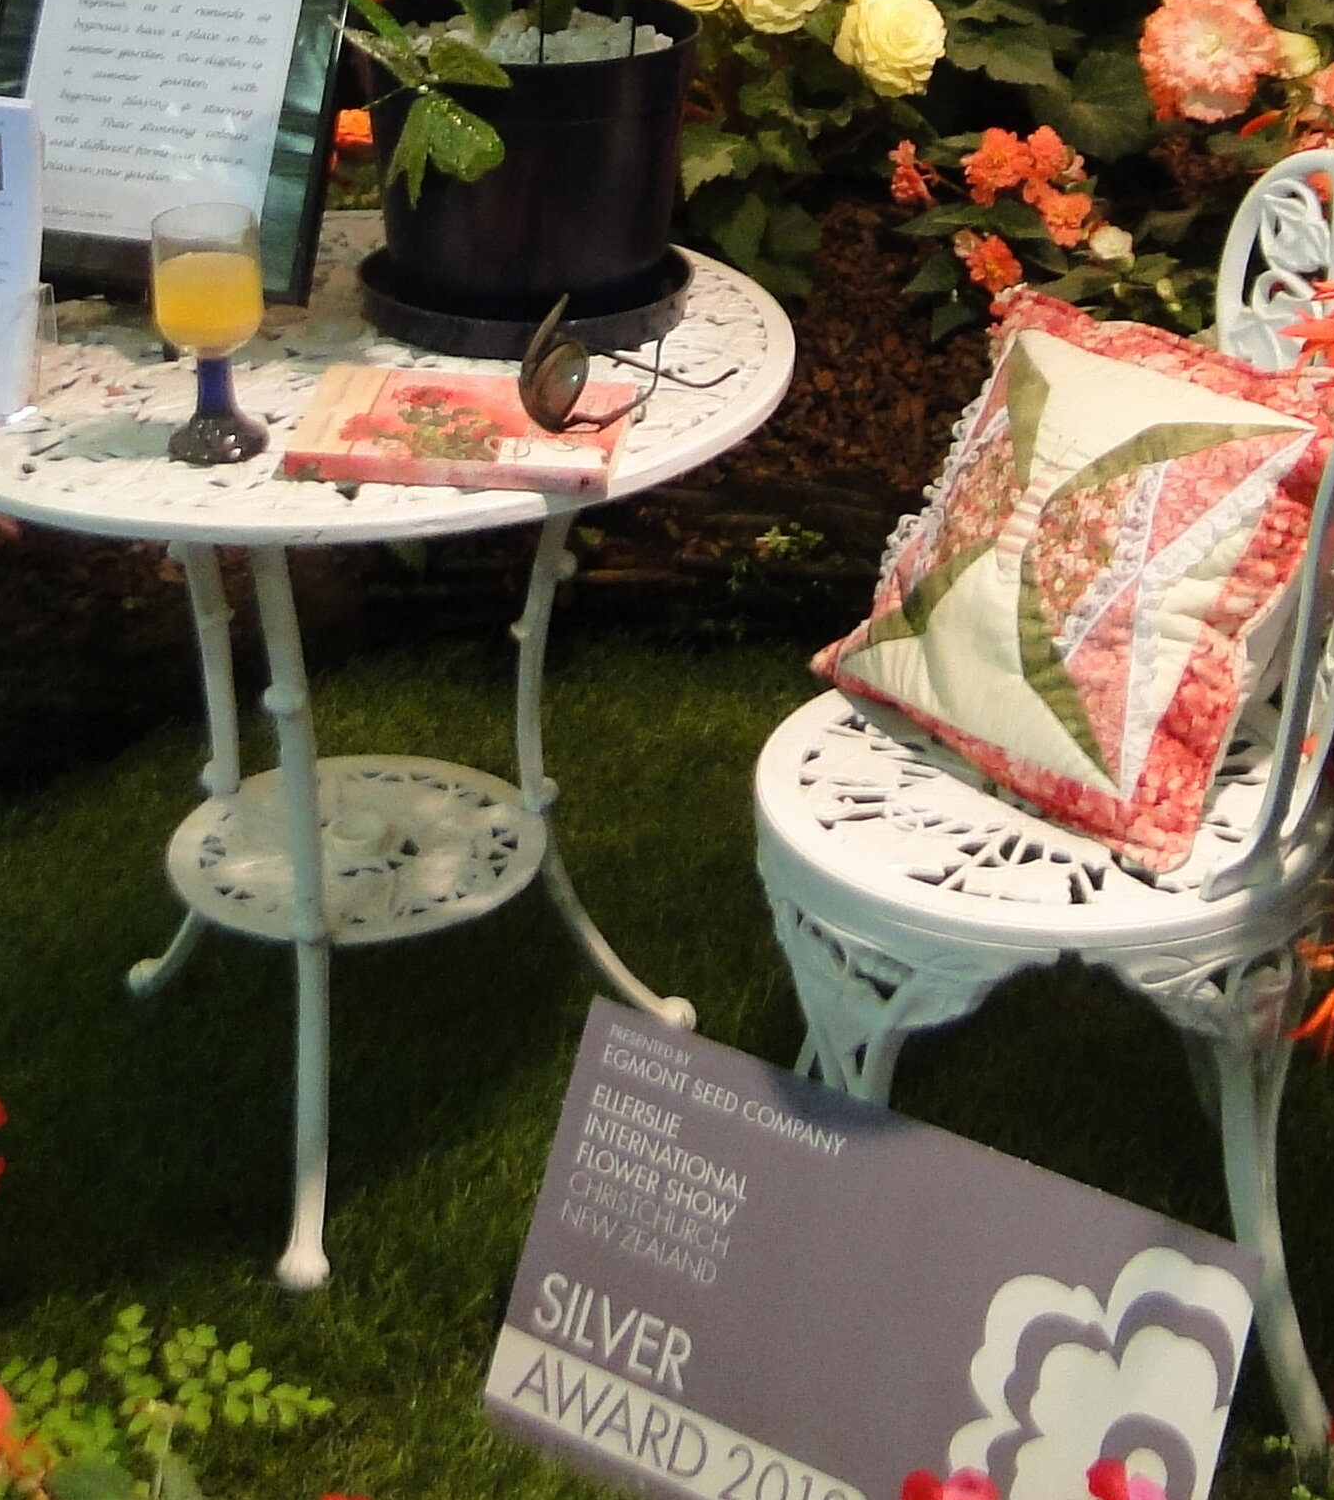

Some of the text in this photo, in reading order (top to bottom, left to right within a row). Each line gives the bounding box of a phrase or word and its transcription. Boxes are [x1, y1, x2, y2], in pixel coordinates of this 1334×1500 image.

[610, 1023, 692, 1067] PRESENTED BY
[592, 1084, 683, 1138] ELLERSLIE
[603, 1043, 848, 1156] EGMONT SEED COMPANY
[576, 1141, 737, 1225] FLOWER SHOW
[584, 1112, 747, 1201] INTERNATIONAL
[561, 1199, 717, 1284] NEW ZEALAND
[570, 1171, 730, 1259] CHRISTCHURCH
[533, 1271, 693, 1392] SILVER
[511, 1351, 848, 1500] AWARD 20
